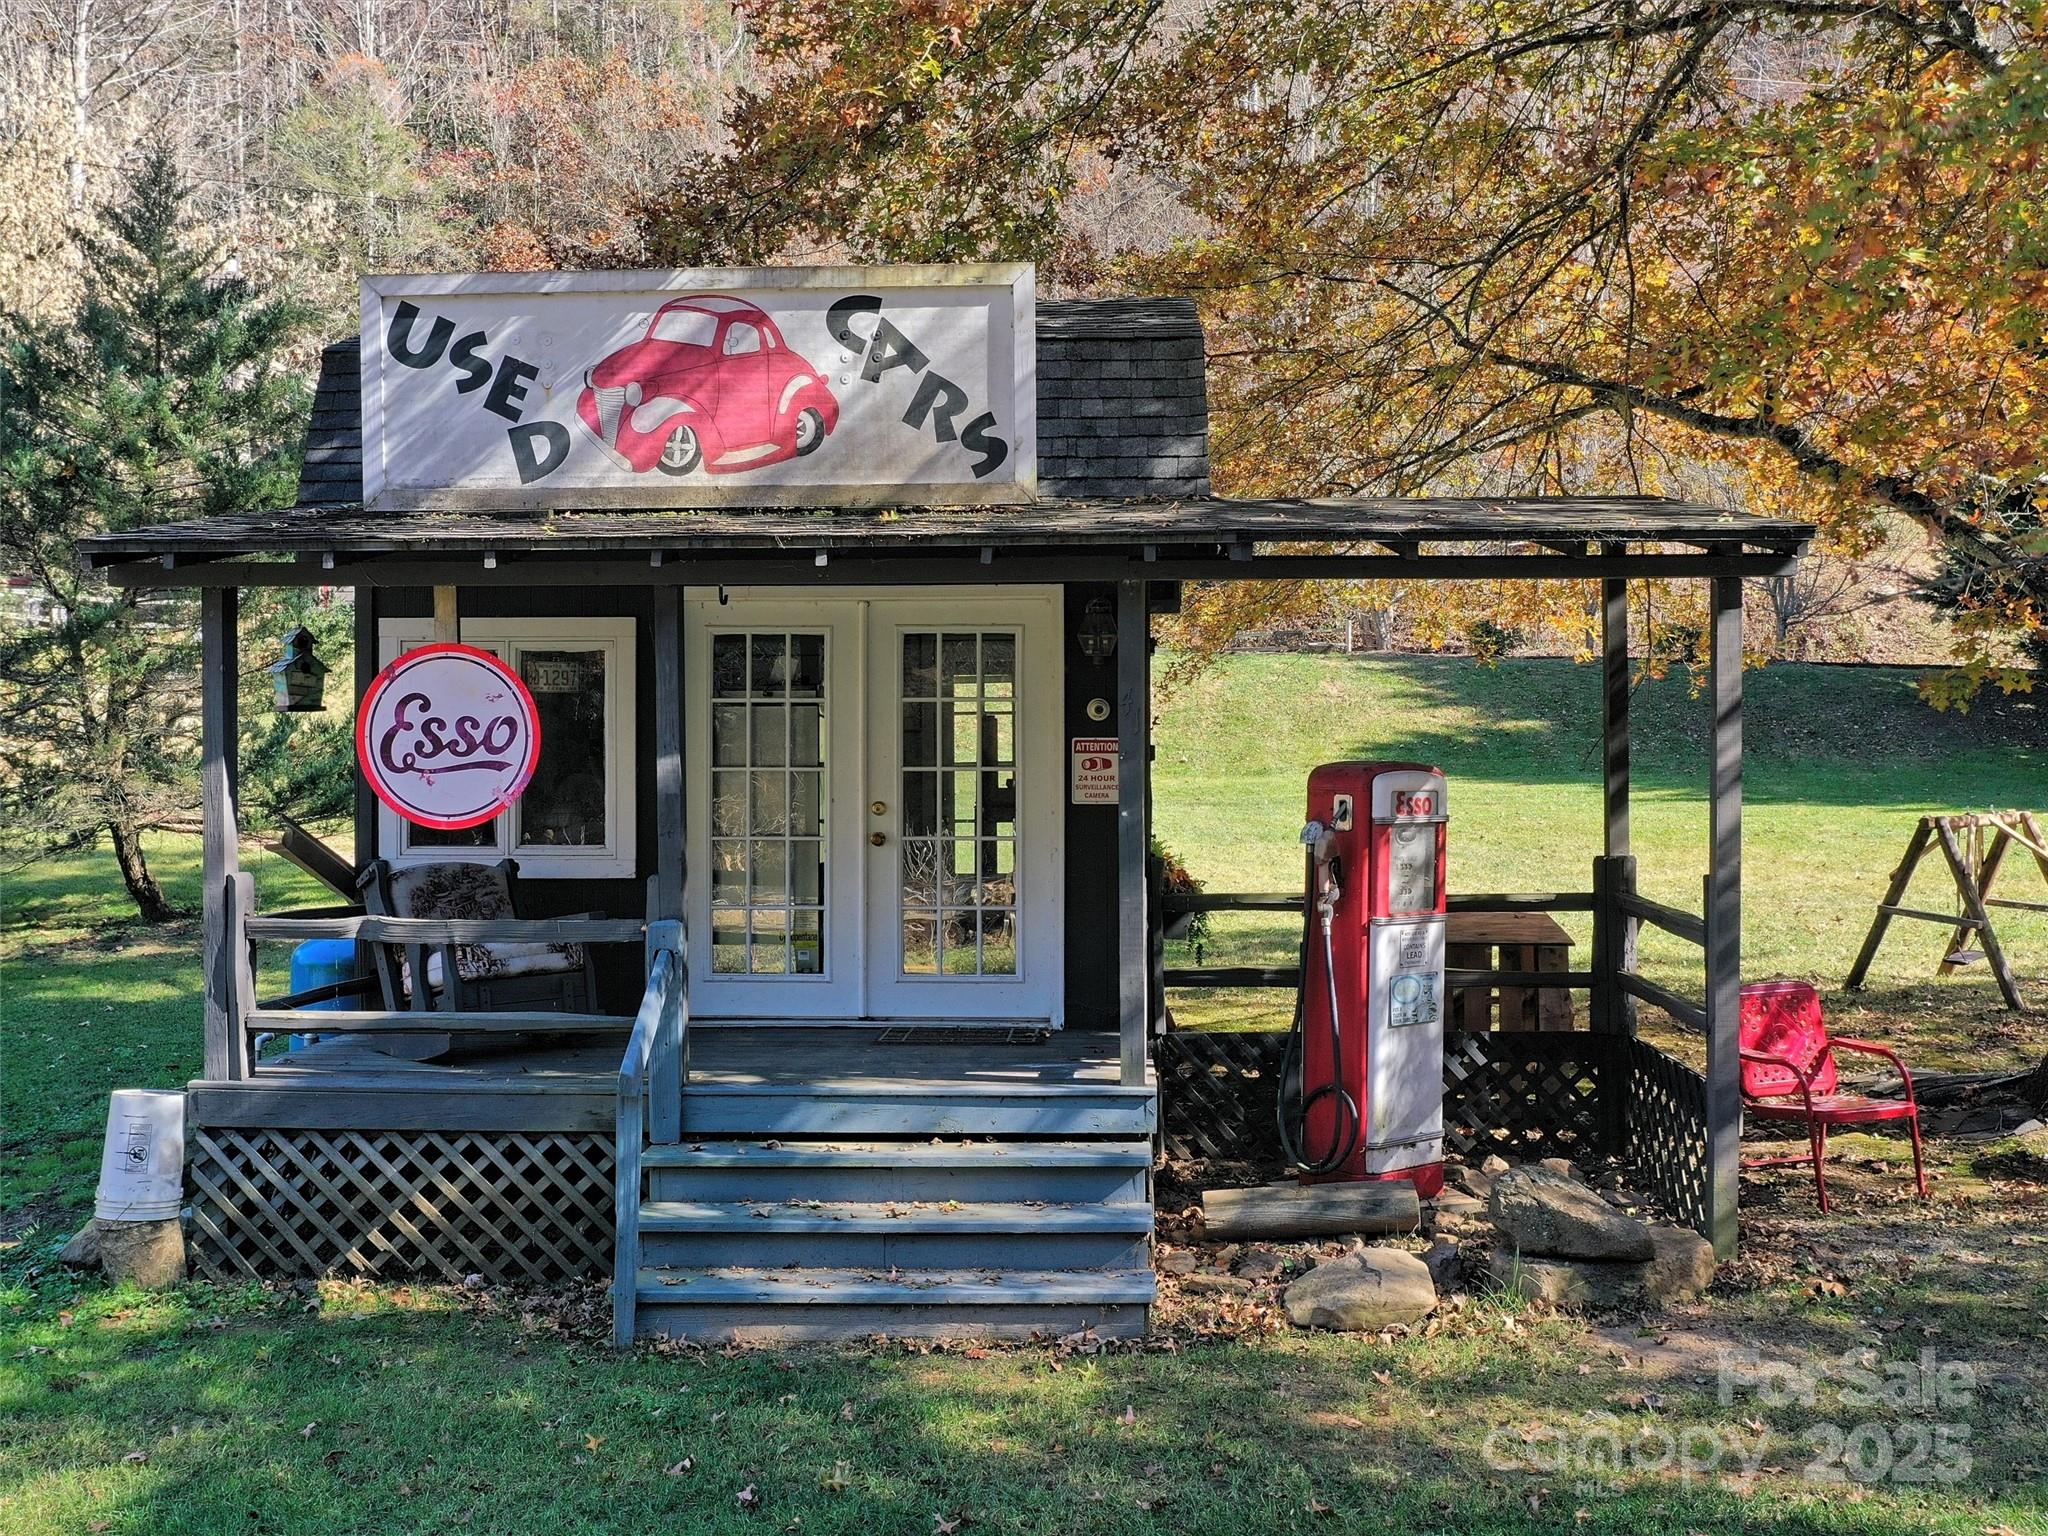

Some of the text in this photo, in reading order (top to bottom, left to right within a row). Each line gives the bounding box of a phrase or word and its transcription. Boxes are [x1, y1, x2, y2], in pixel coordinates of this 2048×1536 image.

[386, 295, 1008, 485] USED CARS
[379, 692, 518, 775] Esso
[1075, 742, 1119, 752] ATTENTION
[1403, 943, 1426, 951] CONTAINS
[1406, 950, 1423, 960] LEAD
